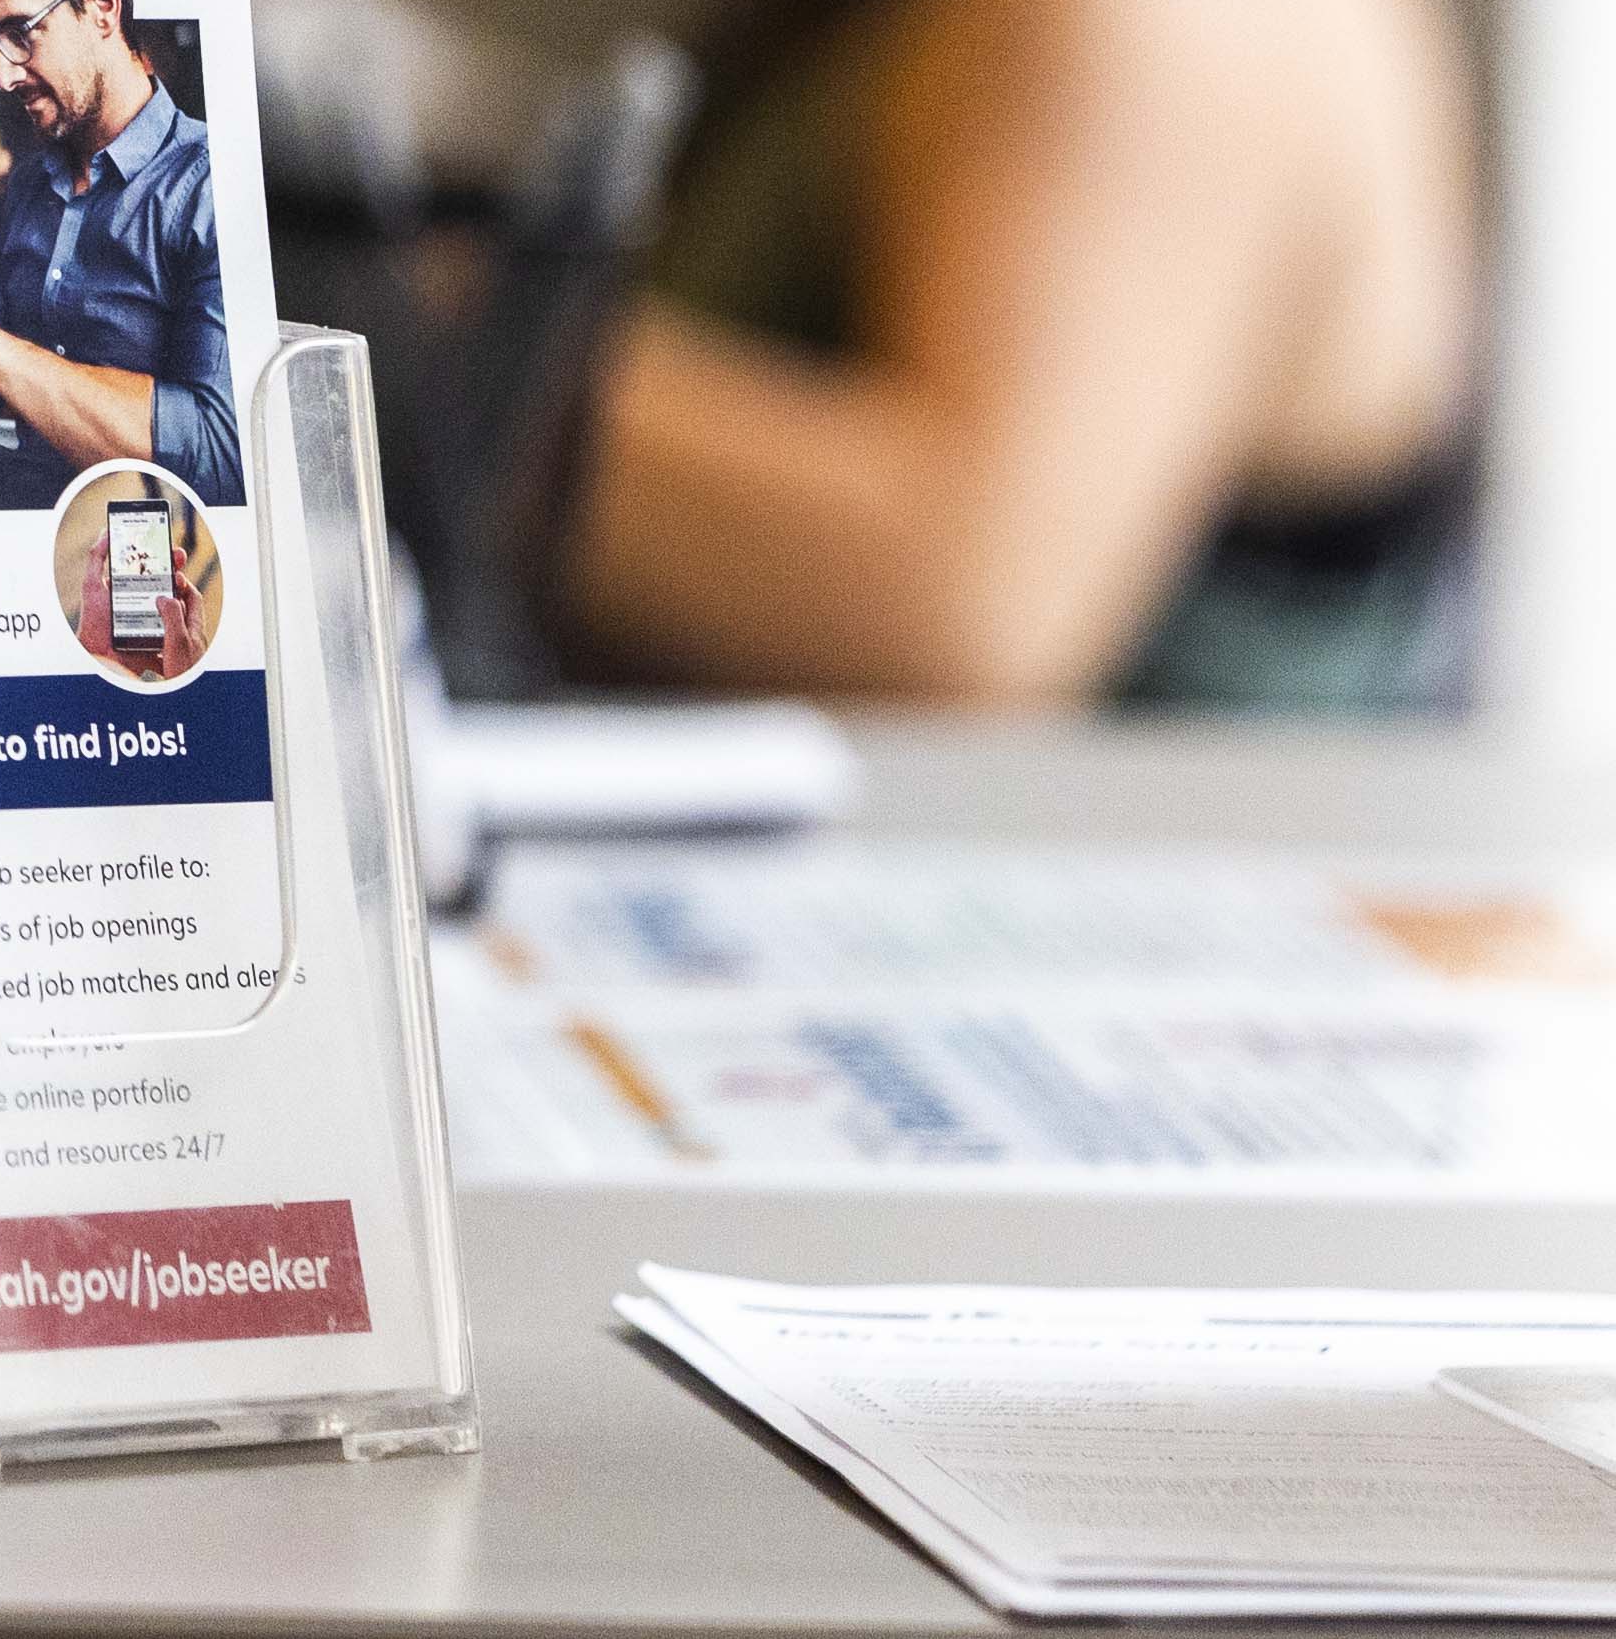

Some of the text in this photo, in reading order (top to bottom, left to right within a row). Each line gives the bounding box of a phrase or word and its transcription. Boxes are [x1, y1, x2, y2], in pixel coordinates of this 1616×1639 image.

[34, 723, 102, 760] find
[107, 723, 187, 766] jobs!
[19, 858, 93, 885] seeker
[100, 854, 174, 886] profile
[179, 856, 211, 880] to:
[18, 914, 42, 941] of
[46, 912, 85, 946] job
[91, 912, 198, 943] openings
[37, 970, 75, 1004] job
[81, 967, 179, 996] matches
[185, 963, 230, 990] and
[236, 962, 307, 989] alers
[15, 1083, 85, 1111] online
[92, 1077, 192, 1112] portfolio
[5, 1142, 50, 1169] and
[57, 1139, 168, 1167] resources
[174, 1131, 227, 1160] 24/7
